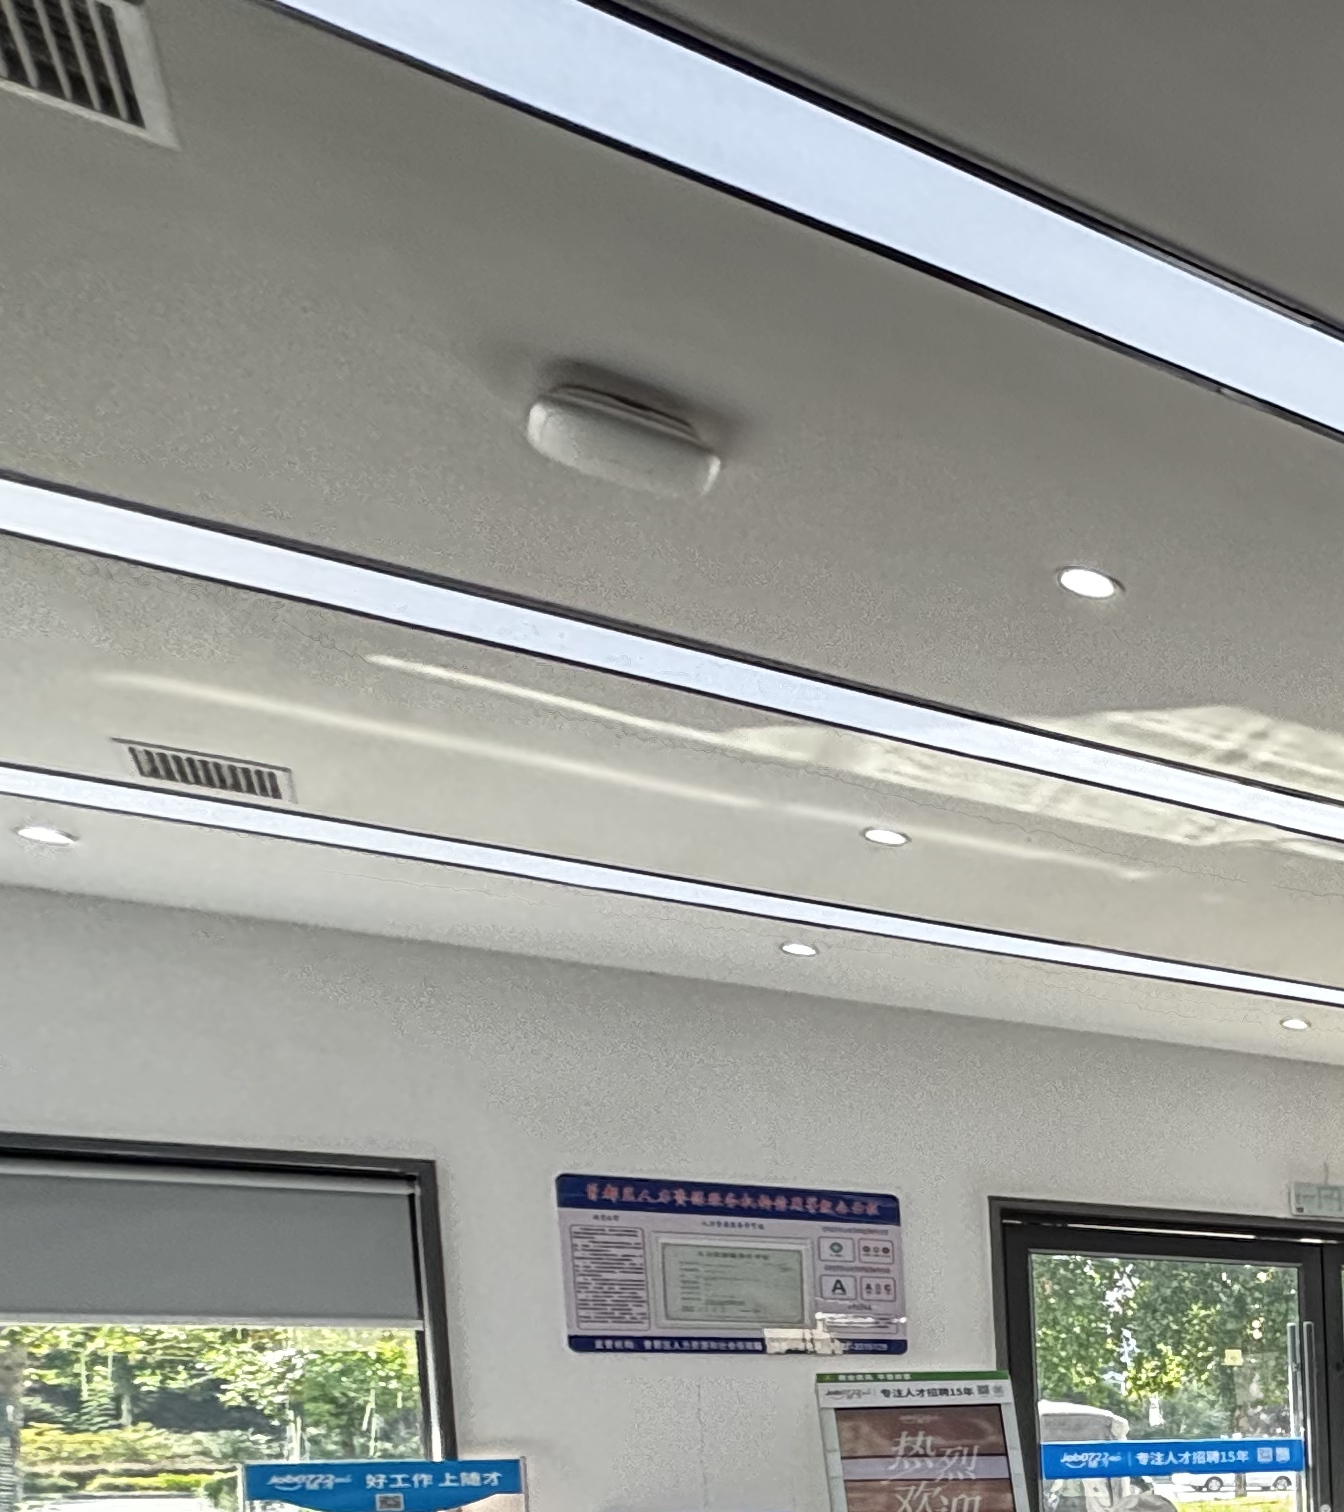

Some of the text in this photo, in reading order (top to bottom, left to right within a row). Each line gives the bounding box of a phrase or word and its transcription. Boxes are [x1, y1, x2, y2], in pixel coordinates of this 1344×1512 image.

[880, 1386, 975, 1398] 专注人才招聘15年
[889, 1430, 980, 1481] 热烈
[1135, 1450, 1250, 1466] 专注人才招聘15年
[365, 1471, 502, 1489] 好工作 上随才
